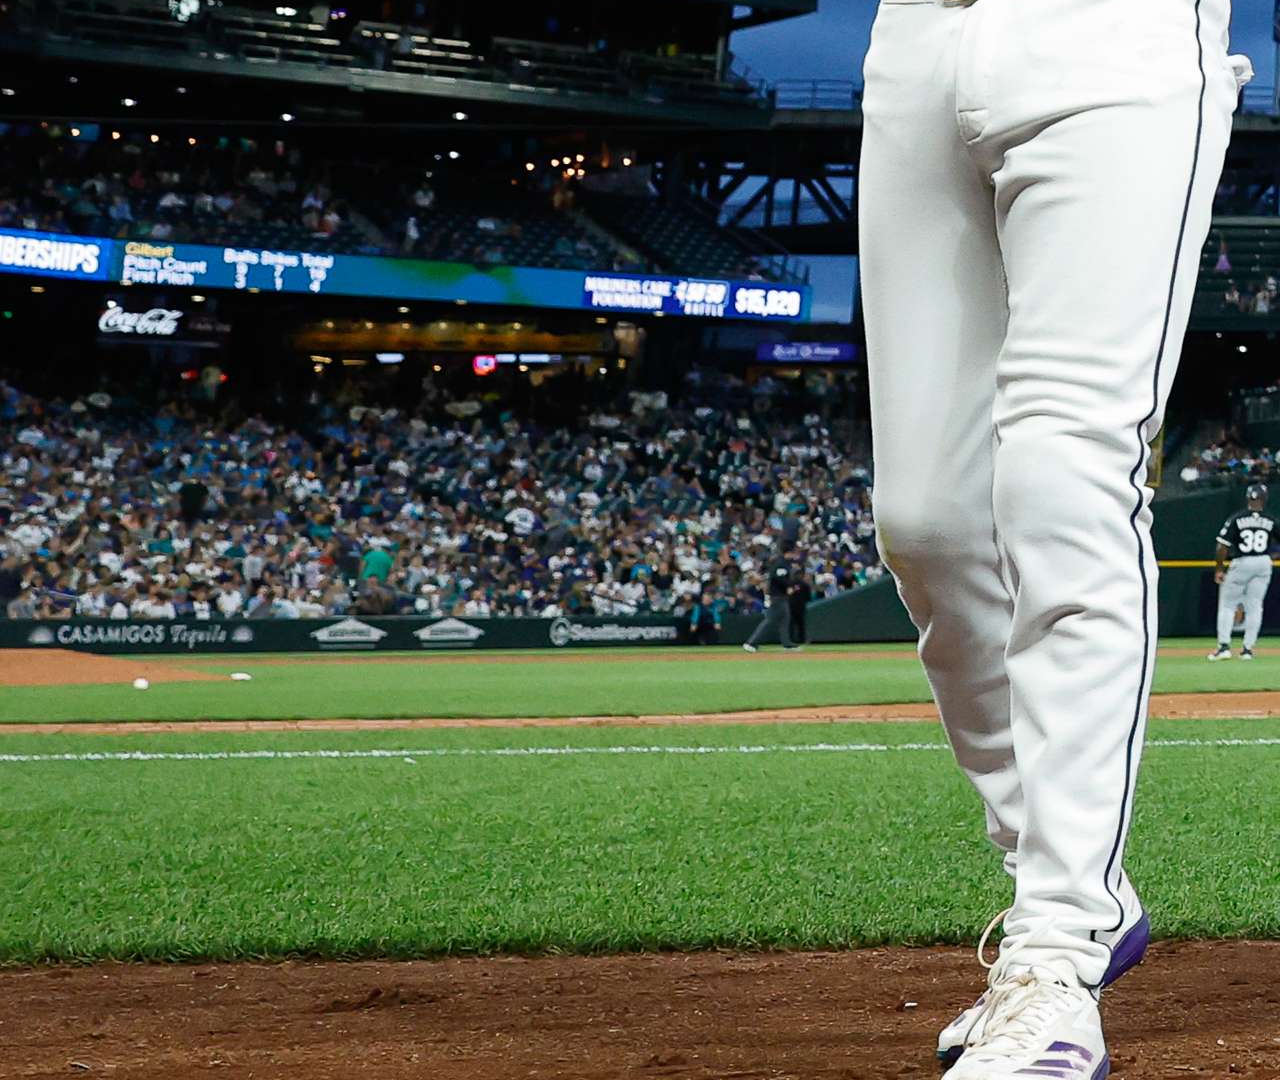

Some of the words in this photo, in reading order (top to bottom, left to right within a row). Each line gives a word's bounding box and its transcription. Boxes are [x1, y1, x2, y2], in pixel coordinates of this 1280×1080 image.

[1238, 529, 1269, 553] 38
[57, 624, 165, 644] CASAMIGOS
[168, 624, 227, 649] Tequila
